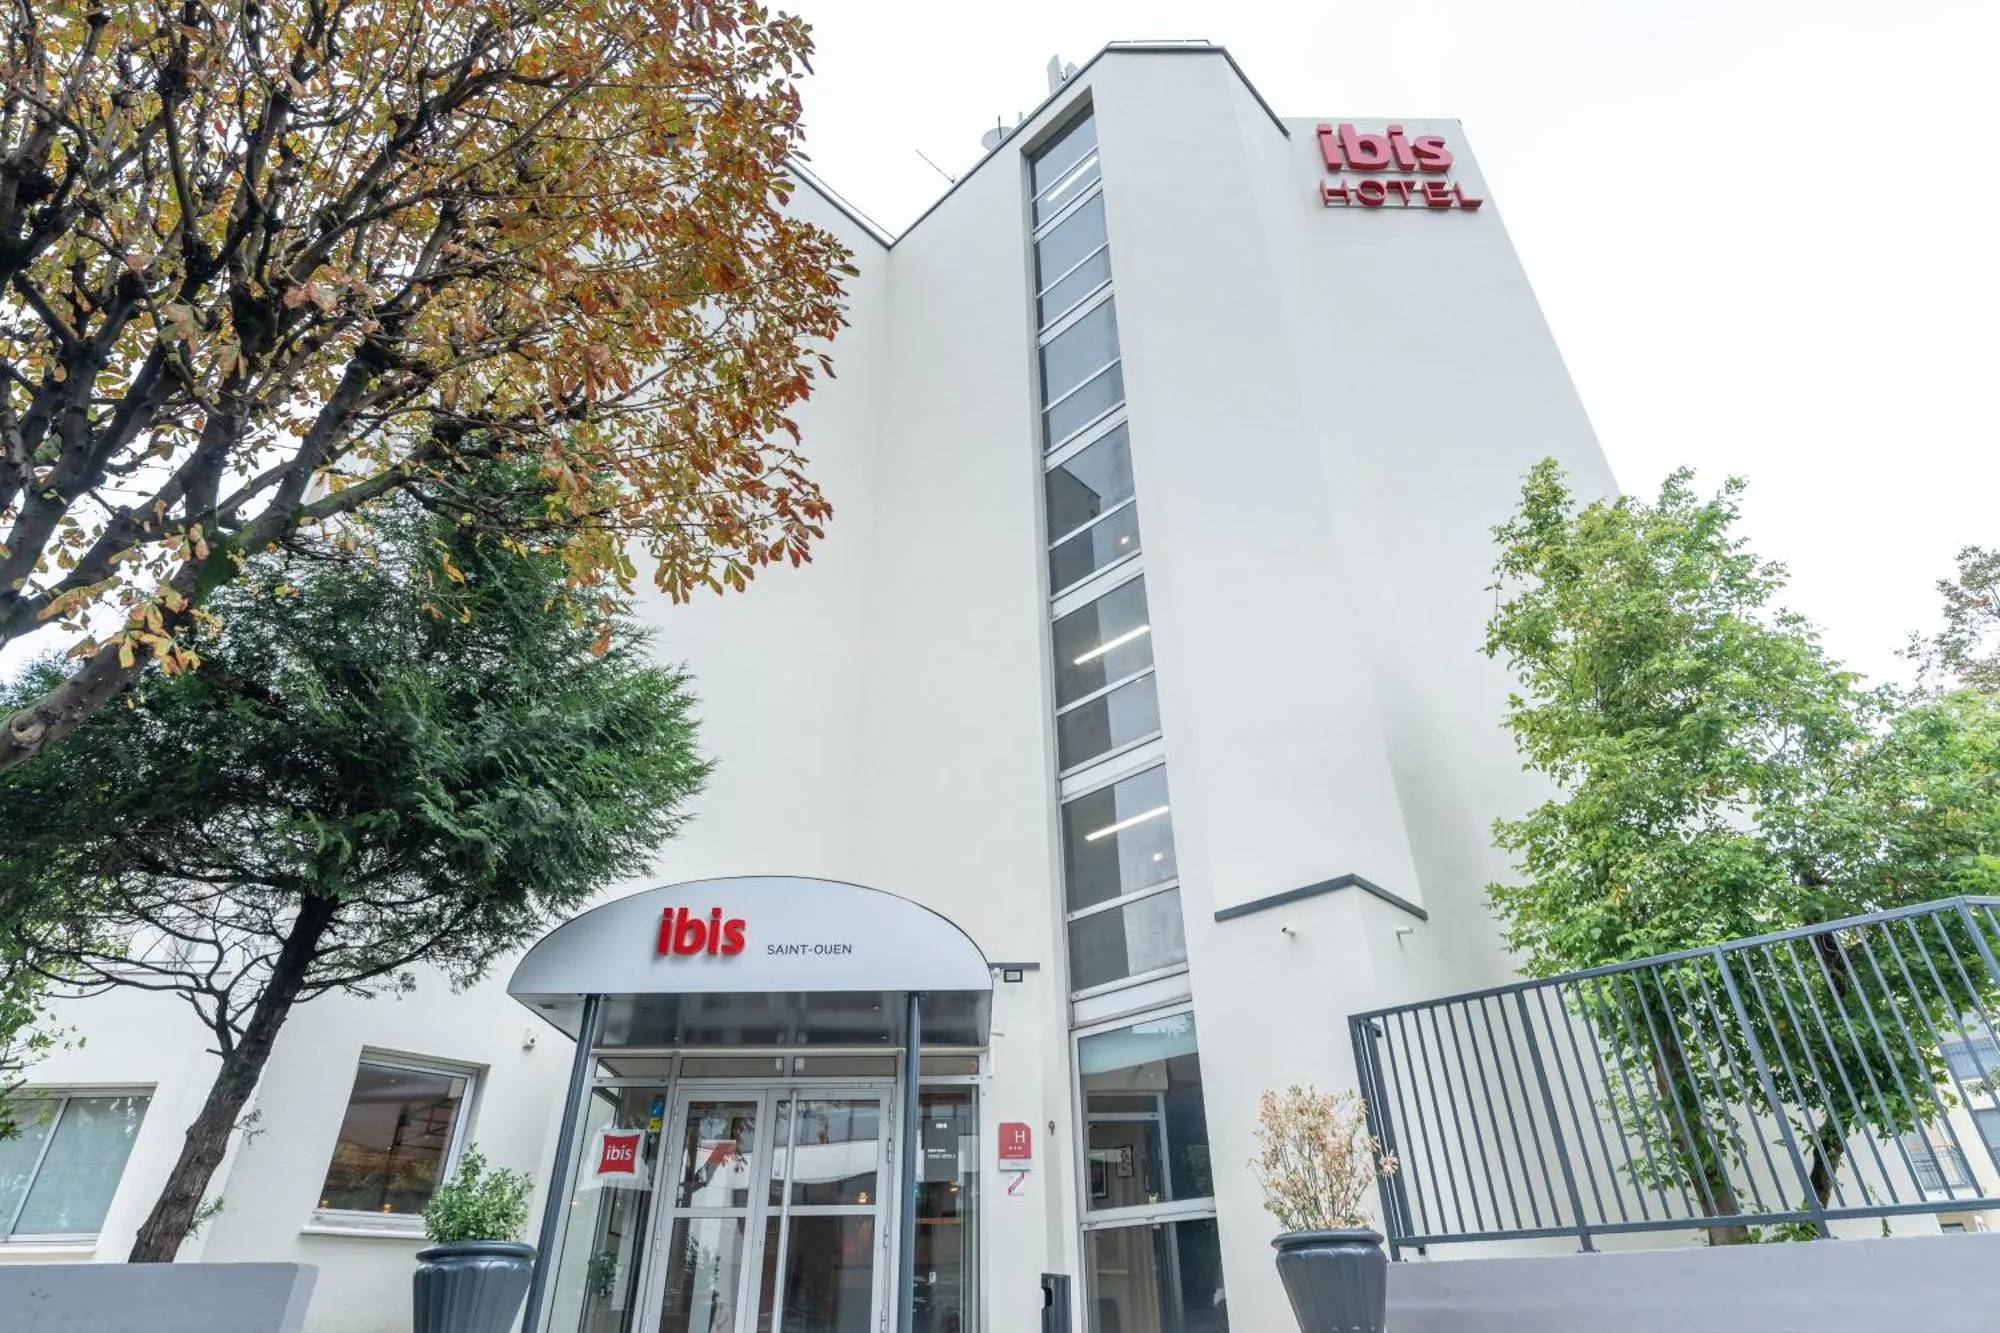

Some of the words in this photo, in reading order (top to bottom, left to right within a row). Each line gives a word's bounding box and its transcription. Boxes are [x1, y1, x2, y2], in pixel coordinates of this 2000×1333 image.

[1316, 123, 1453, 172] ibis
[1319, 178, 1484, 209] HOTEL
[656, 907, 747, 957] ibis
[766, 943, 853, 955] SAINT-OUEN
[606, 1144, 633, 1161] ibis
[1014, 1130, 1026, 1144] H
